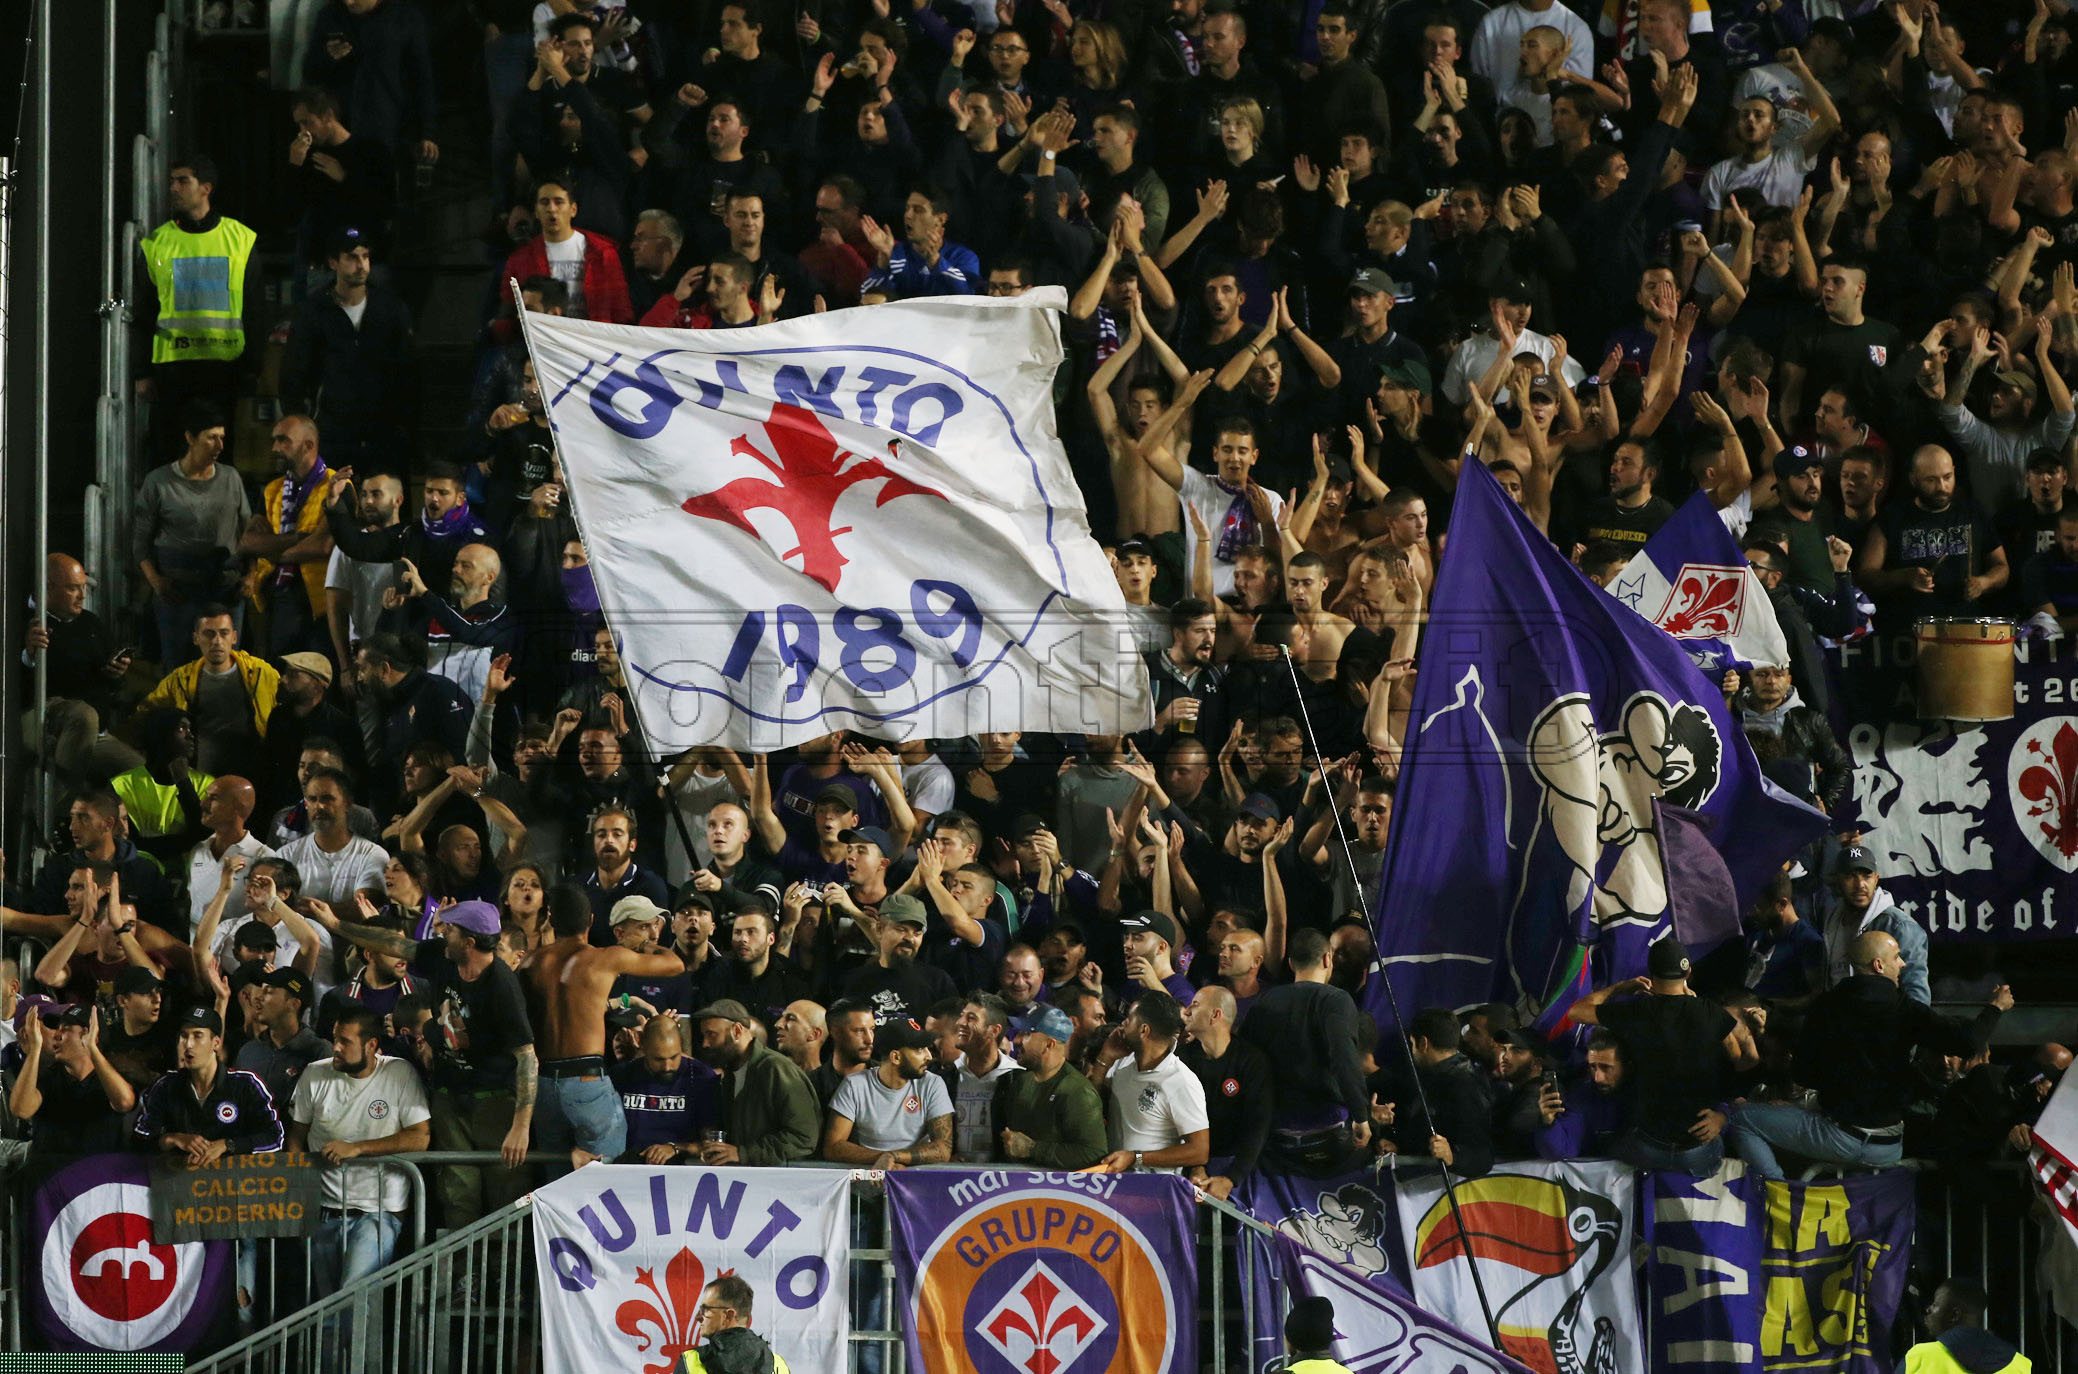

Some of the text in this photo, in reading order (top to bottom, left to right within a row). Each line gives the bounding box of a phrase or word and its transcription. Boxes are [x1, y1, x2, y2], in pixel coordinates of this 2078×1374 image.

[721, 579, 984, 703] 1989
[1900, 886, 2058, 934] ride of
[175, 1202, 305, 1225] MODERNO
[191, 1176, 289, 1198] CALCIO
[549, 1172, 830, 1310] QUINTO
[955, 1207, 1122, 1268] GRUPPO
